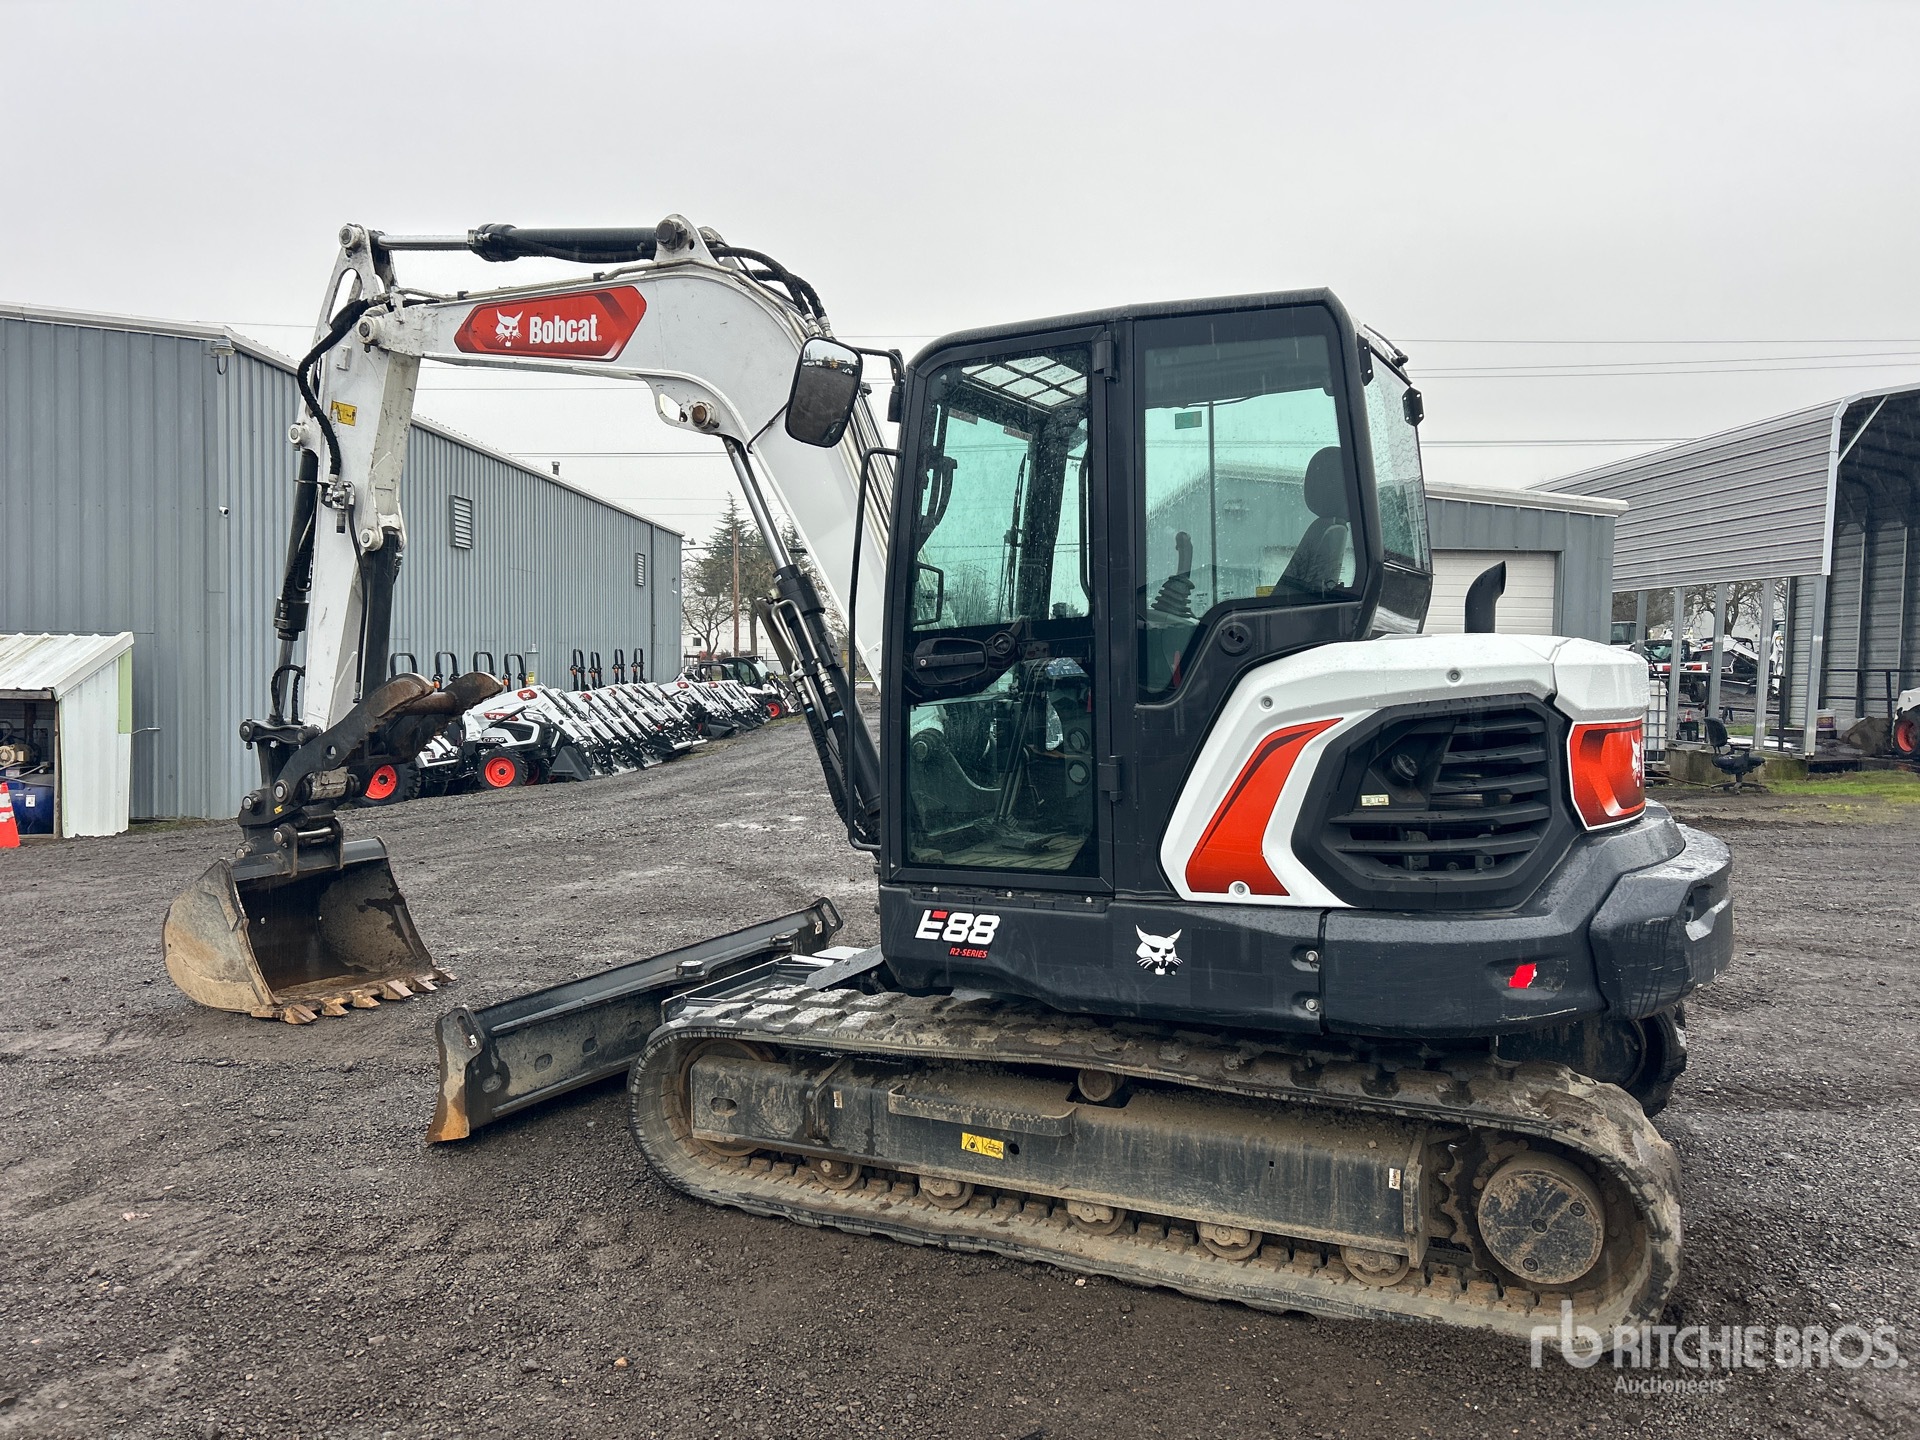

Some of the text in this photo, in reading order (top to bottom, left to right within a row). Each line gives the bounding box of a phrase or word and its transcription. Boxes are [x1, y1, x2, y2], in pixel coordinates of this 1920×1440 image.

[529, 314, 598, 344] Bobcat
[914, 909, 1001, 945] E88
[949, 947, 988, 959] R2-SERIES
